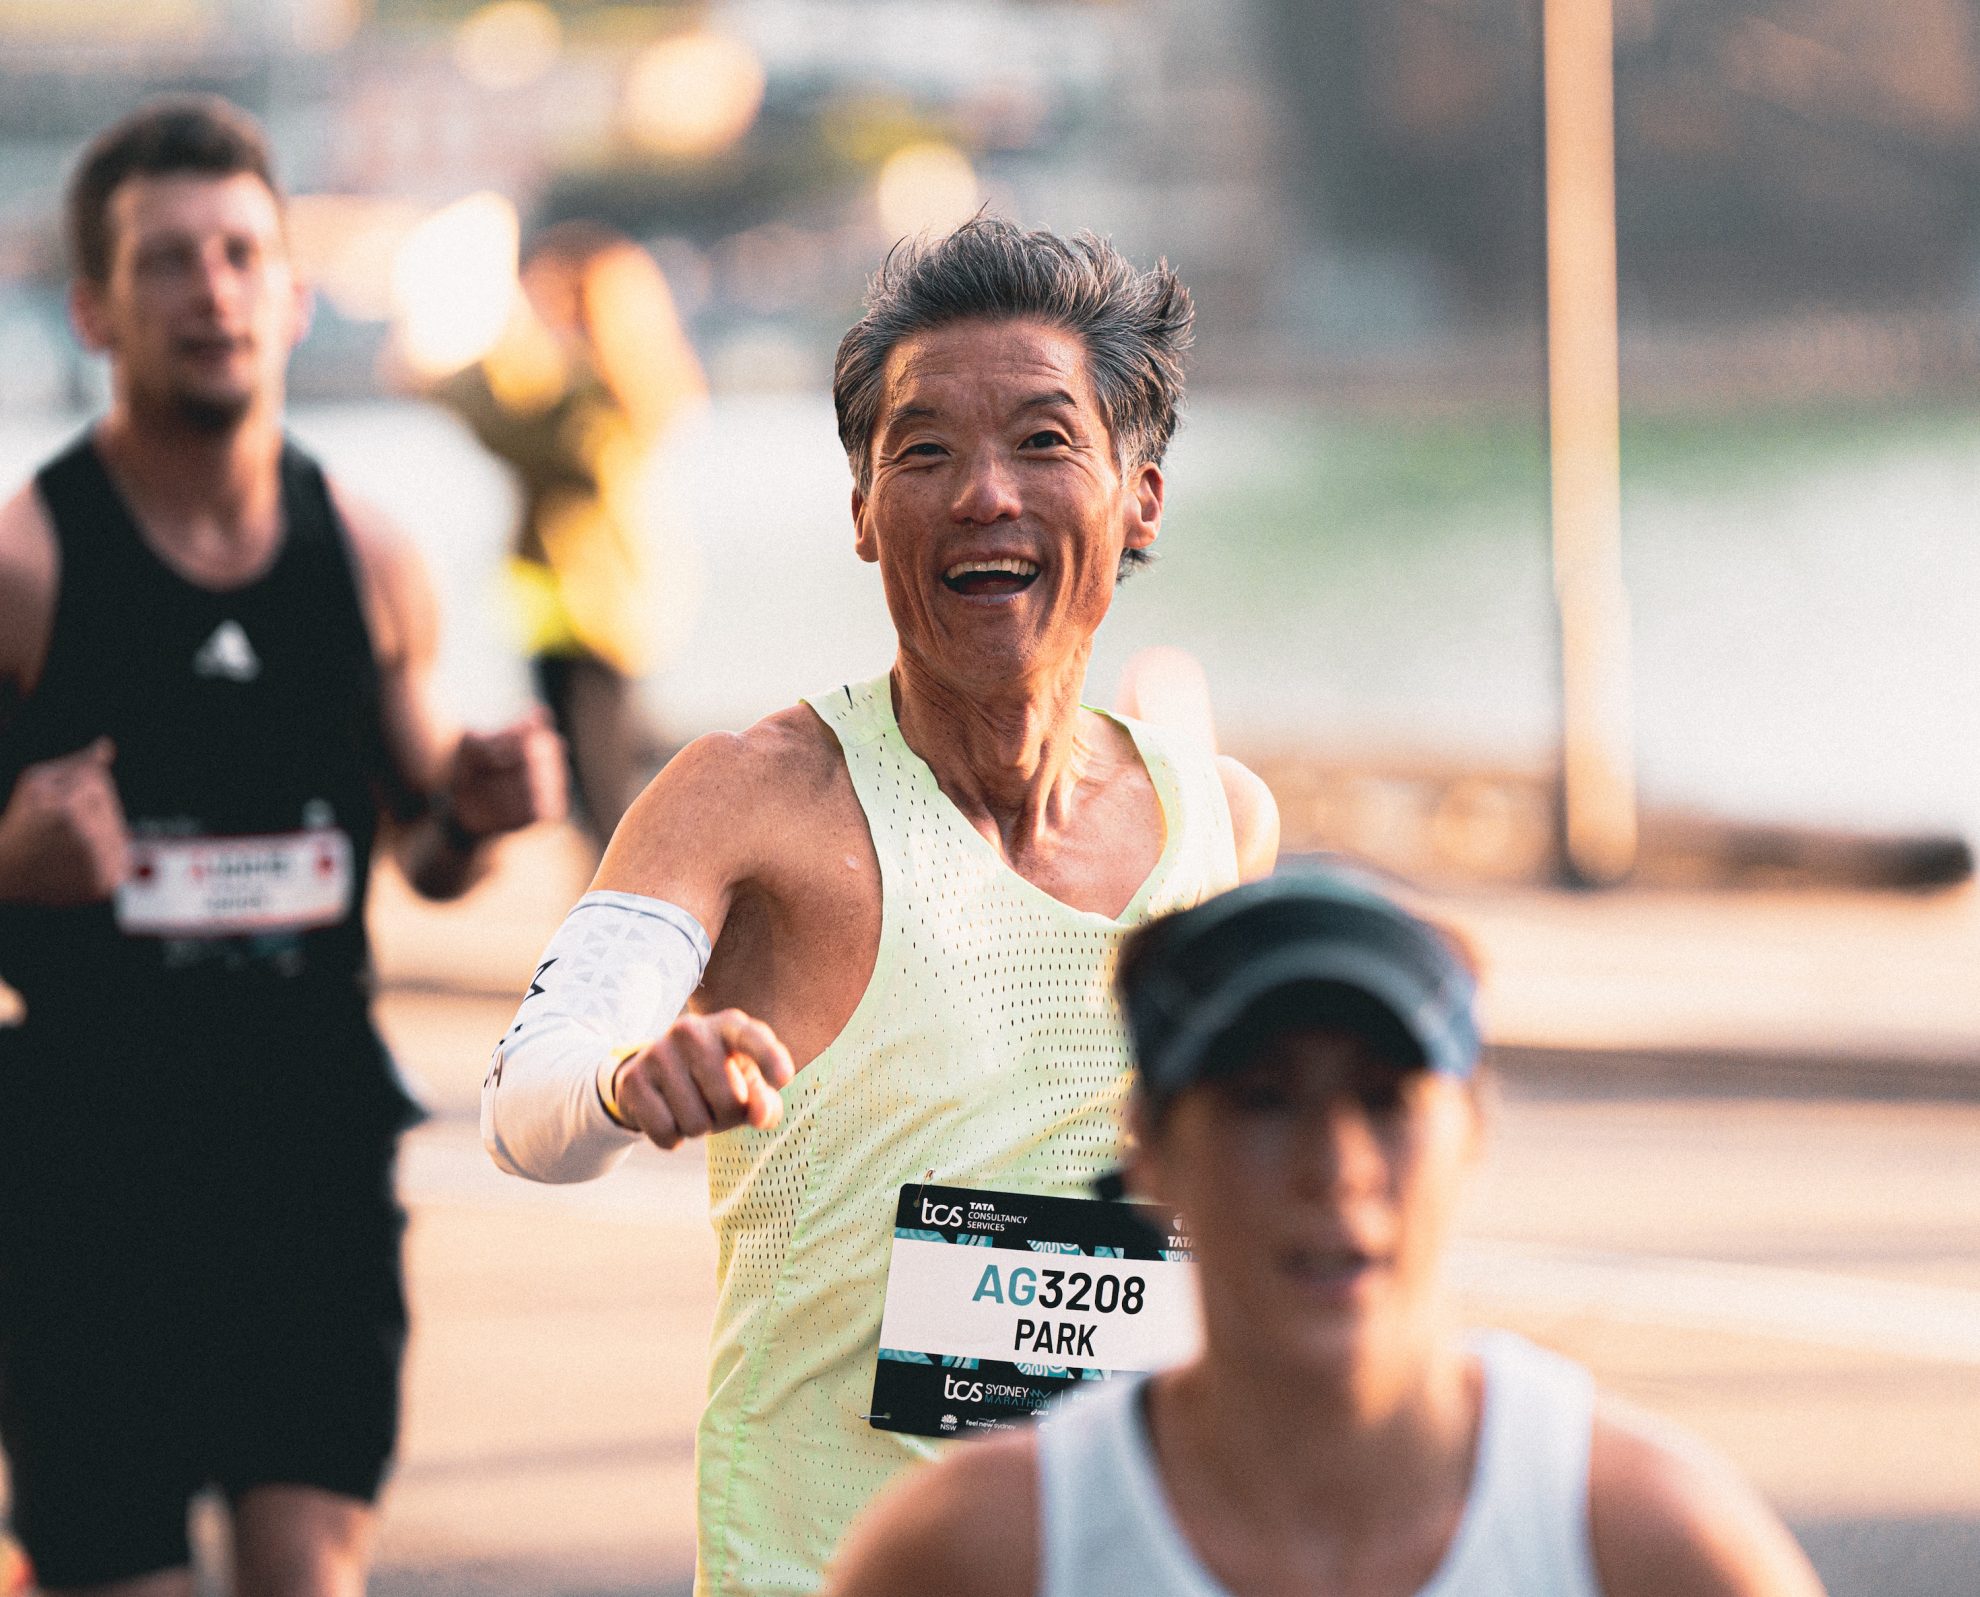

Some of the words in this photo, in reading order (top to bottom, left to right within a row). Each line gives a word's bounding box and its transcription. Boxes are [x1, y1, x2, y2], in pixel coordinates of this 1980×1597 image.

[921, 1197, 964, 1227] tcs
[969, 1202, 995, 1212] TATA
[968, 1211, 1028, 1224] CONSULTANCY
[967, 1220, 1005, 1232] SERVICES
[972, 1264, 1146, 1315] AG3208
[1014, 1318, 1098, 1357] PARK
[944, 1374, 983, 1402] tcs
[985, 1383, 1030, 1398] SYDNEY
[984, 1394, 1052, 1409] MARATHON
[940, 1423, 958, 1431] NSW
[965, 1419, 978, 1427] feel
[979, 1420, 994, 1428] new
